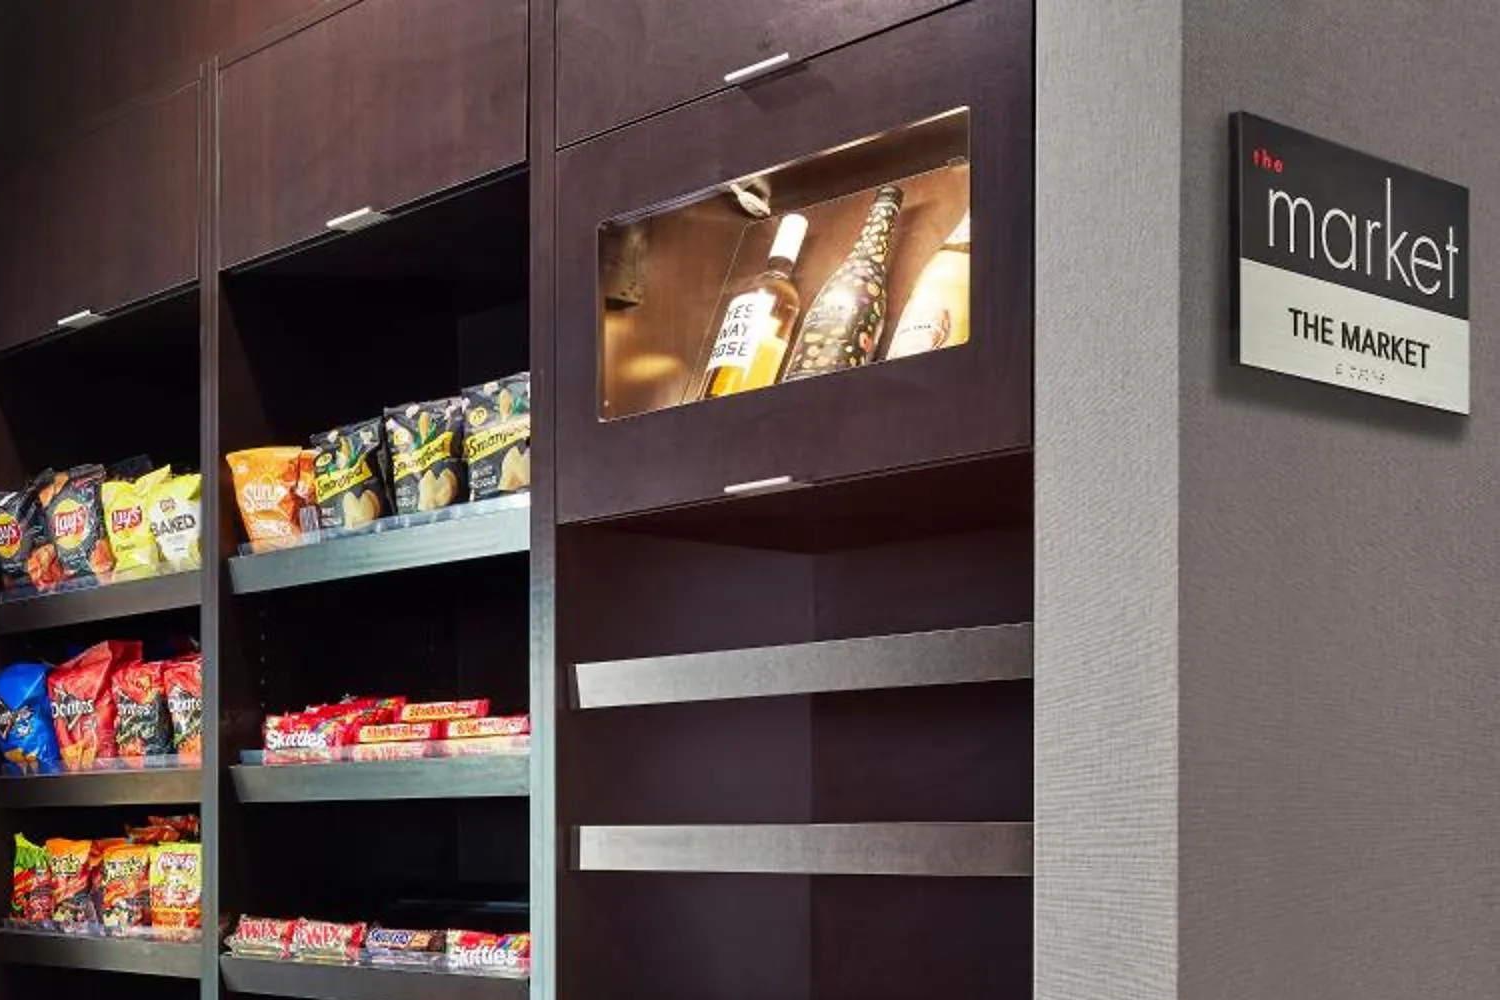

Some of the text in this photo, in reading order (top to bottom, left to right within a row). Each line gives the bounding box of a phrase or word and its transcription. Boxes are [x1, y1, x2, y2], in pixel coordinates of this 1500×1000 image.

[1253, 149, 1284, 174] the
[1268, 176, 1460, 300] market
[1287, 307, 1431, 370] THE MARKET
